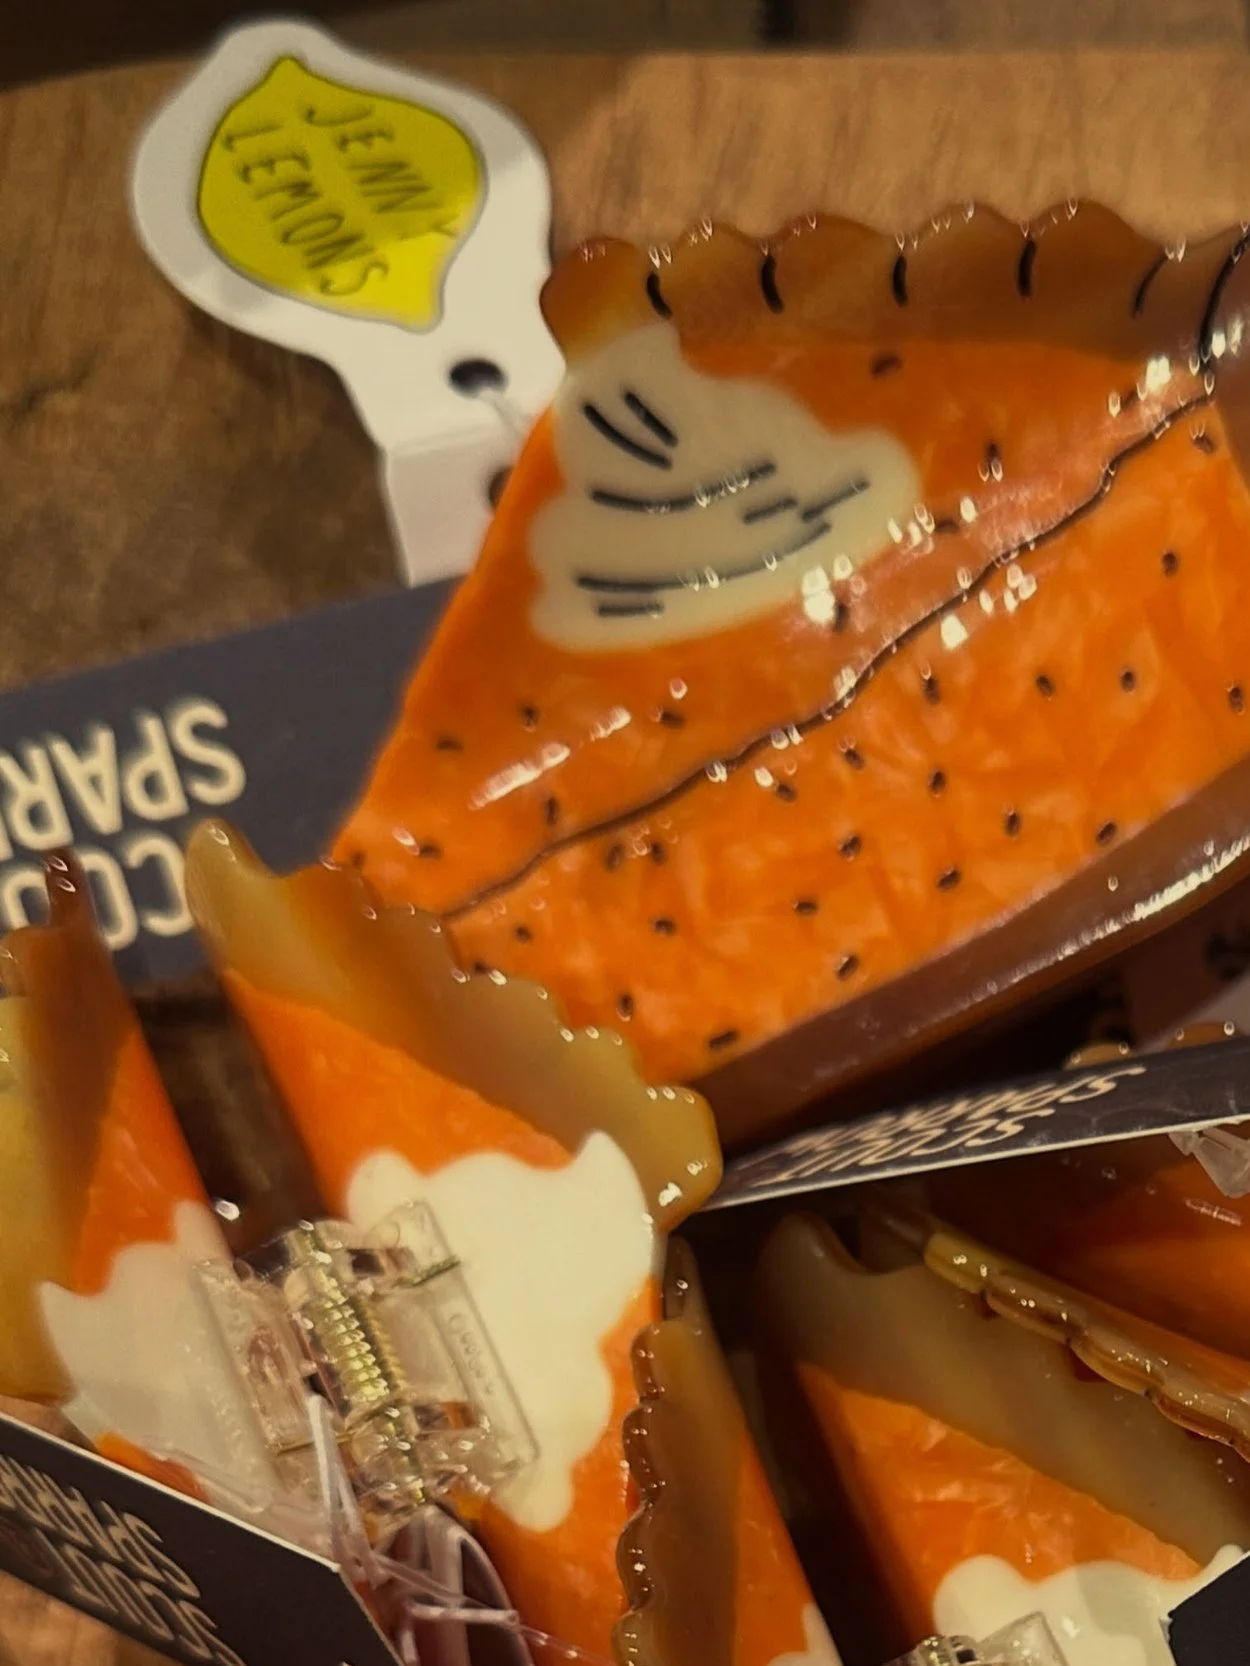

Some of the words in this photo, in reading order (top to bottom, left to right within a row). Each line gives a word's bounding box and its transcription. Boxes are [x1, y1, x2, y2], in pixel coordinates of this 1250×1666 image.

[223, 123, 389, 297] LEMONS
[305, 105, 459, 240] JENNY
[0, 699, 247, 862] SPAR
